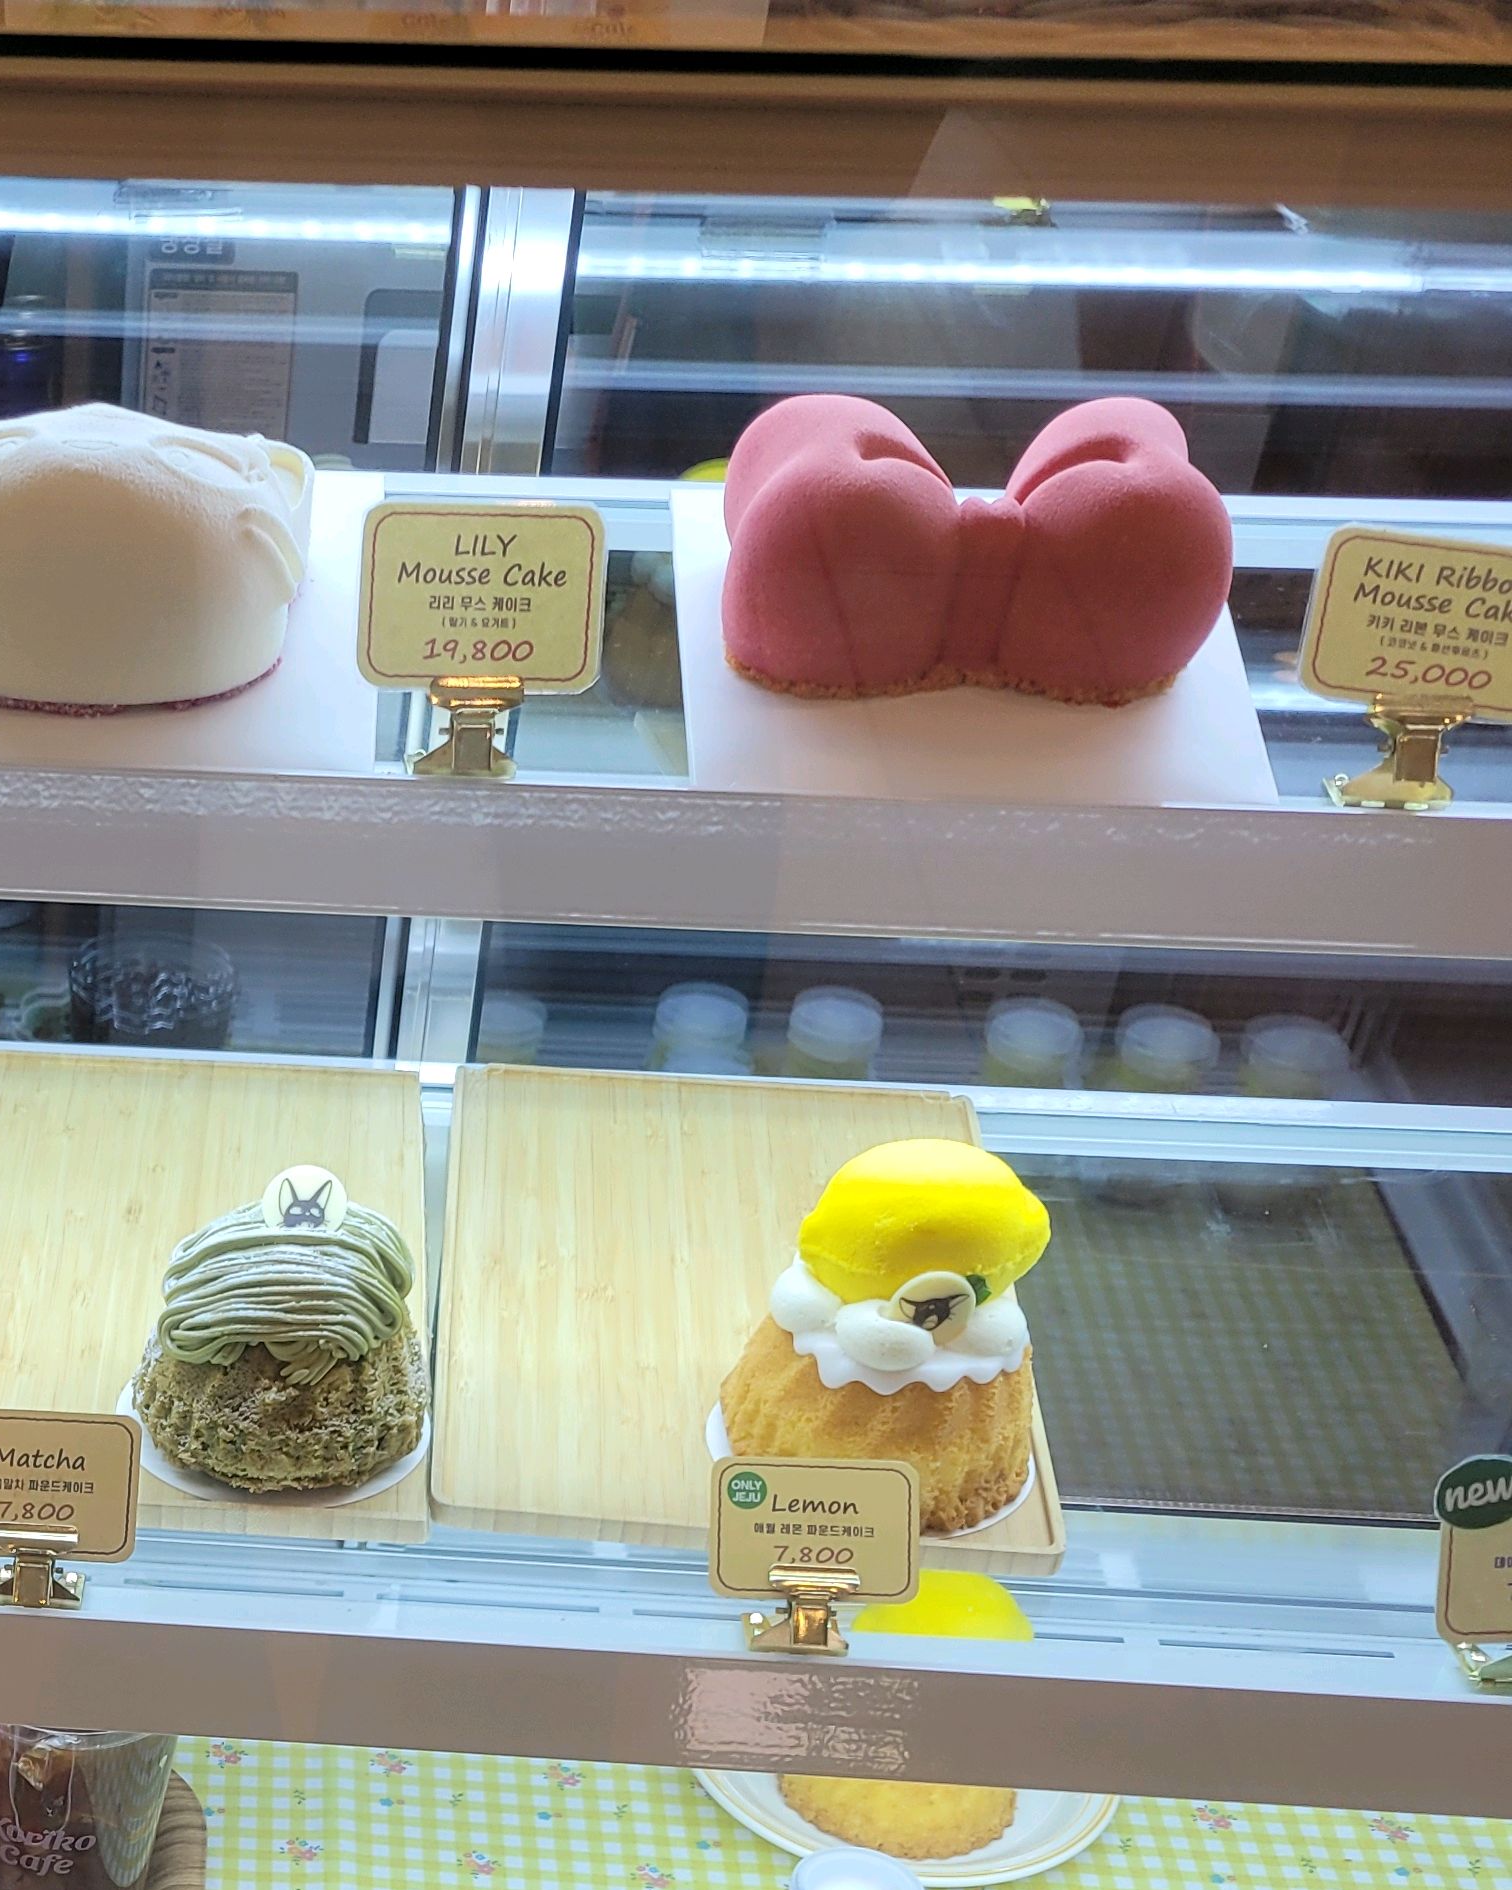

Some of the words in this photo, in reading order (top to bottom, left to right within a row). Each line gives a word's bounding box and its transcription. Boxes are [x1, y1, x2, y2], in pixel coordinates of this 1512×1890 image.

[454, 534, 518, 558] LILY
[397, 561, 491, 585] Mousse
[503, 562, 568, 588] Cake
[1363, 556, 1425, 583] KIKI
[429, 596, 454, 610] 리리
[461, 596, 486, 611] 무스
[492, 597, 531, 612] 케이크
[1353, 582, 1453, 614] Mousse
[1367, 614, 1395, 631] 키키
[1400, 619, 1428, 636] 리본
[1433, 623, 1460, 640] 무스
[1467, 627, 1509, 646] 케이크
[422, 638, 535, 665] 19,800
[1365, 656, 1492, 690] 25,000
[28, 1479, 94, 1494] 파운드케이크
[731, 1479, 763, 1491] ONLY
[732, 1491, 761, 1503] JEJU
[1445, 1476, 1512, 1512] new
[771, 1494, 860, 1516] Lemon
[780, 1523, 803, 1535] 레몬
[807, 1524, 875, 1538] 파운드케이크
[773, 1545, 854, 1564] 7,800
